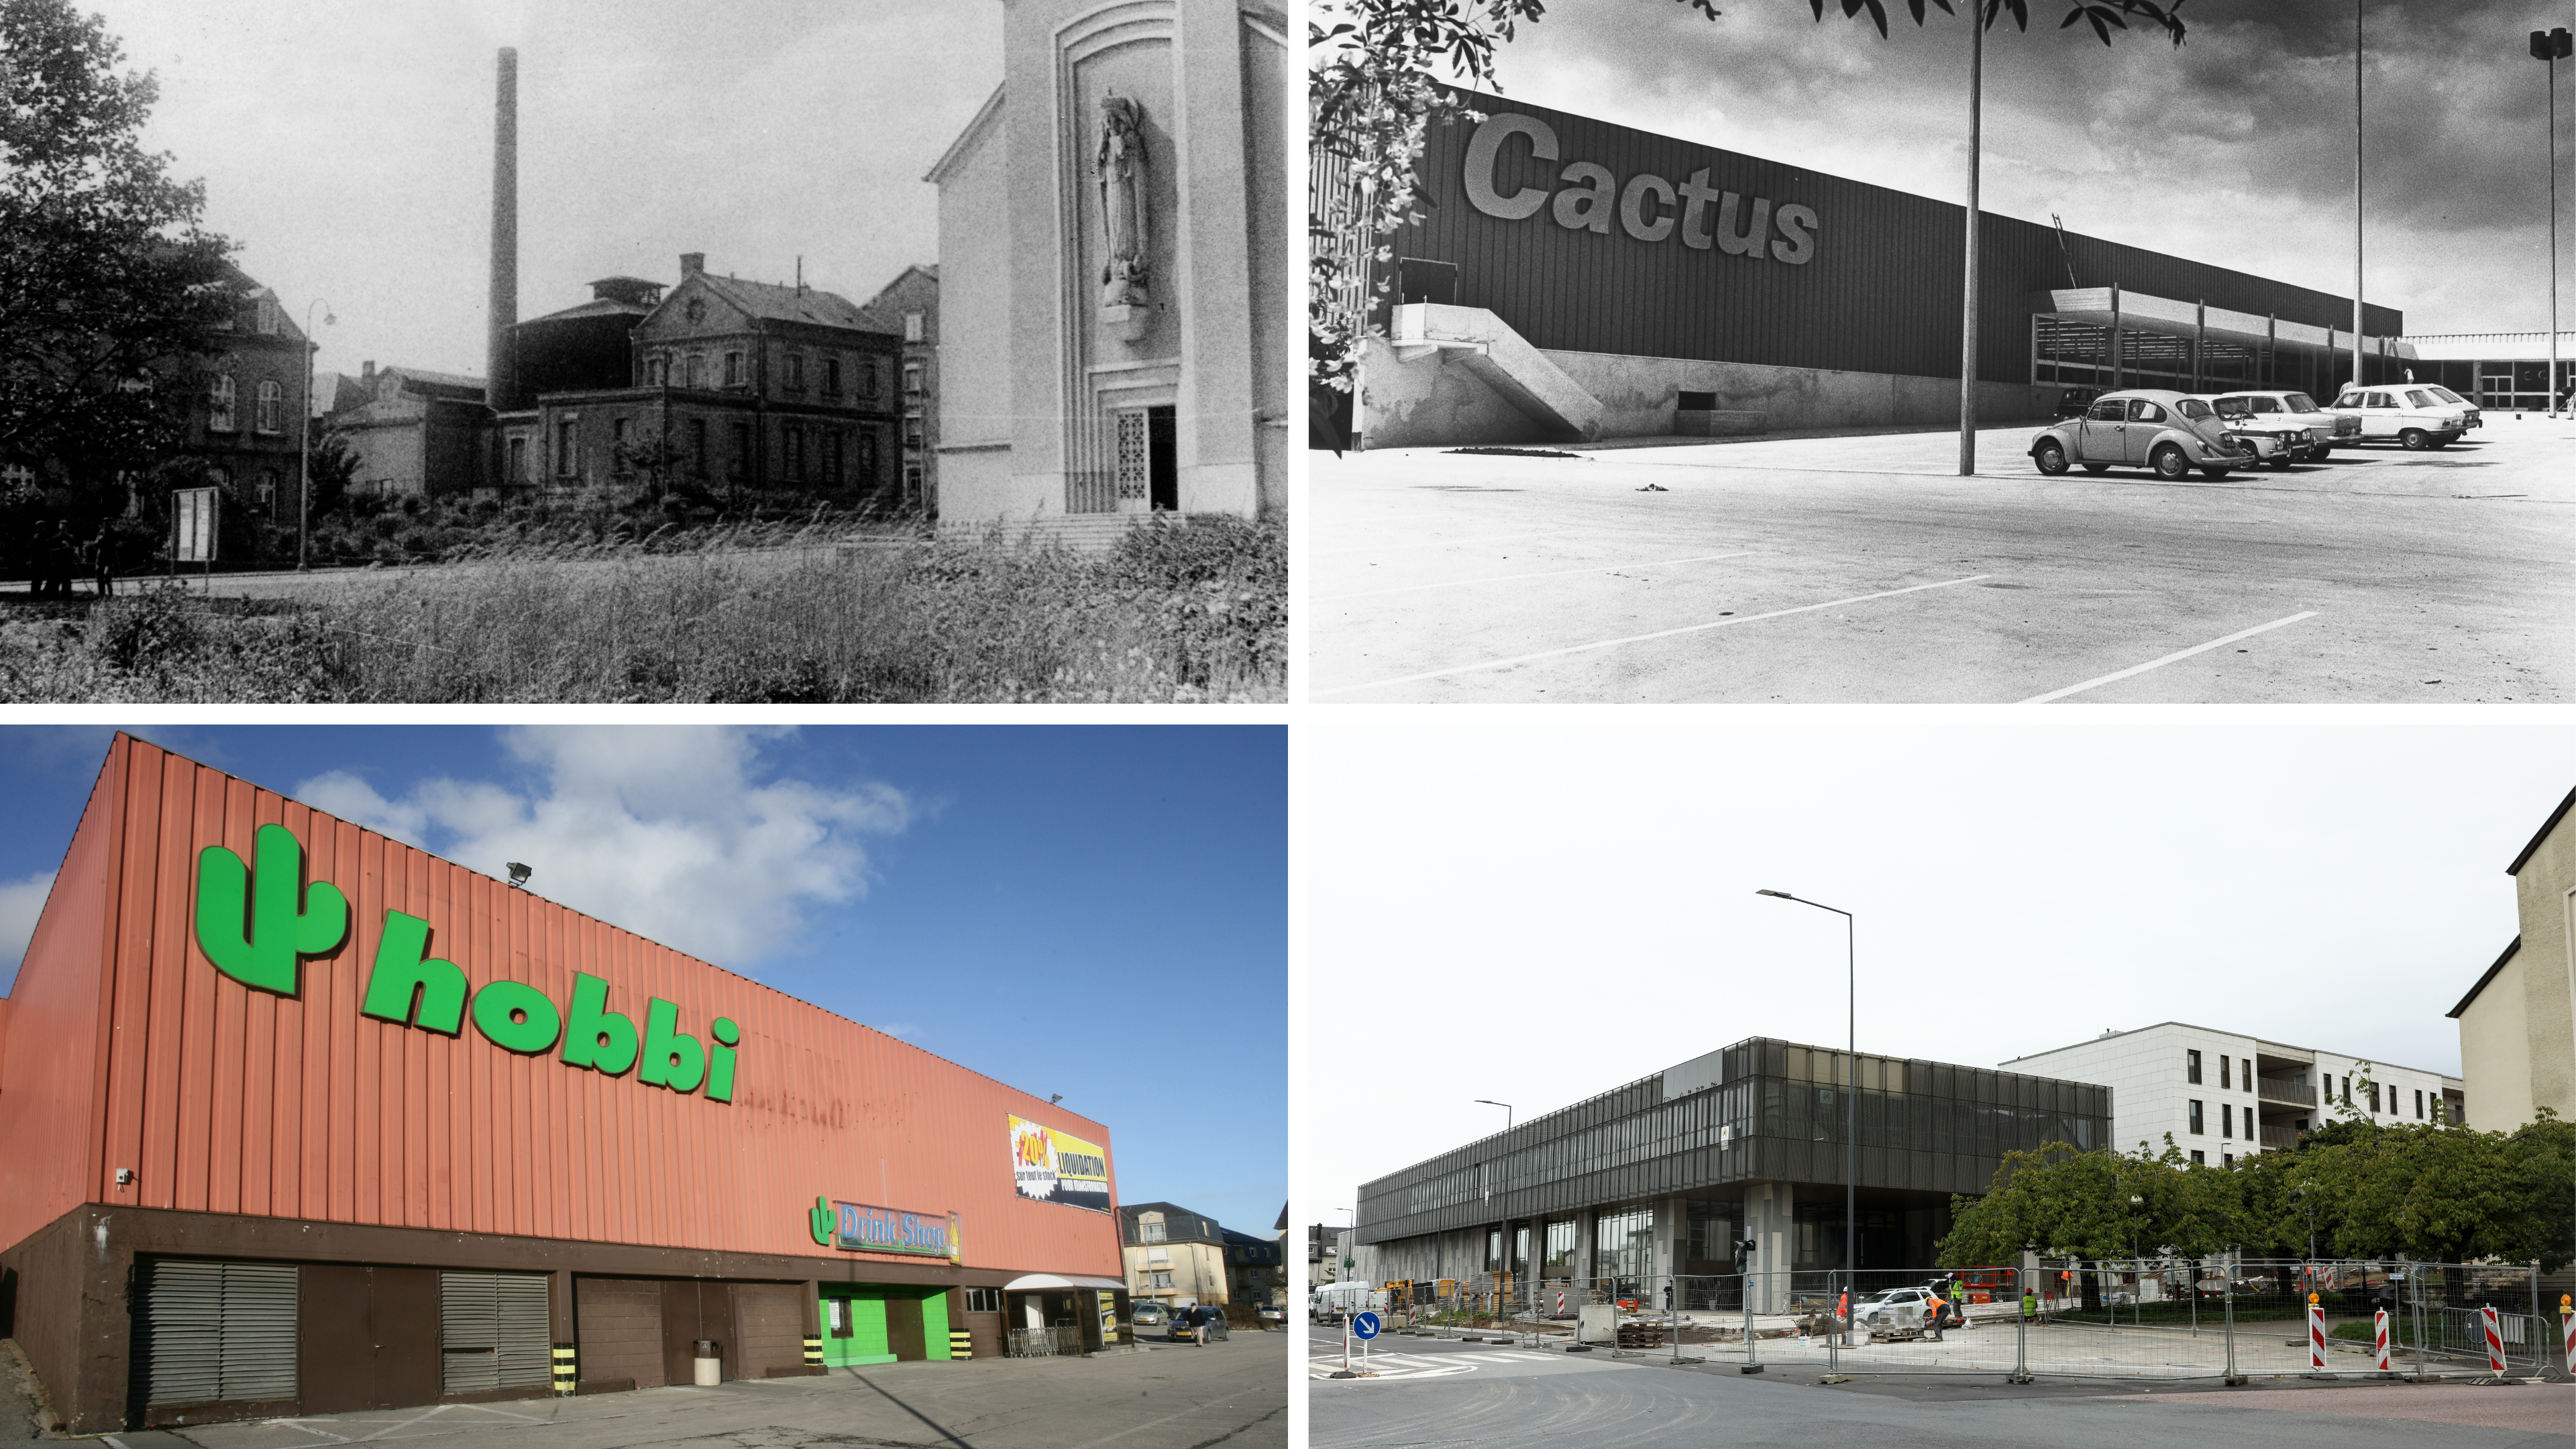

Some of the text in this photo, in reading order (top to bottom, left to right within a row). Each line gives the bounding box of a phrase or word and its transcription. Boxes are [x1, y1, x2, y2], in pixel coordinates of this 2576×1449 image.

[1464, 113, 1818, 264] Cactus
[360, 908, 741, 1104] hobbi
[1016, 1131, 1050, 1170] -20%
[1057, 1151, 1106, 1177] LIQUIDATION
[1016, 1171, 1026, 1181] sur
[1026, 1170, 1037, 1181] tout
[1036, 1170, 1042, 1180] le
[1061, 1179, 1108, 1193] POUR TRANSFORMATION
[842, 1204, 945, 1255] Drink Shop
